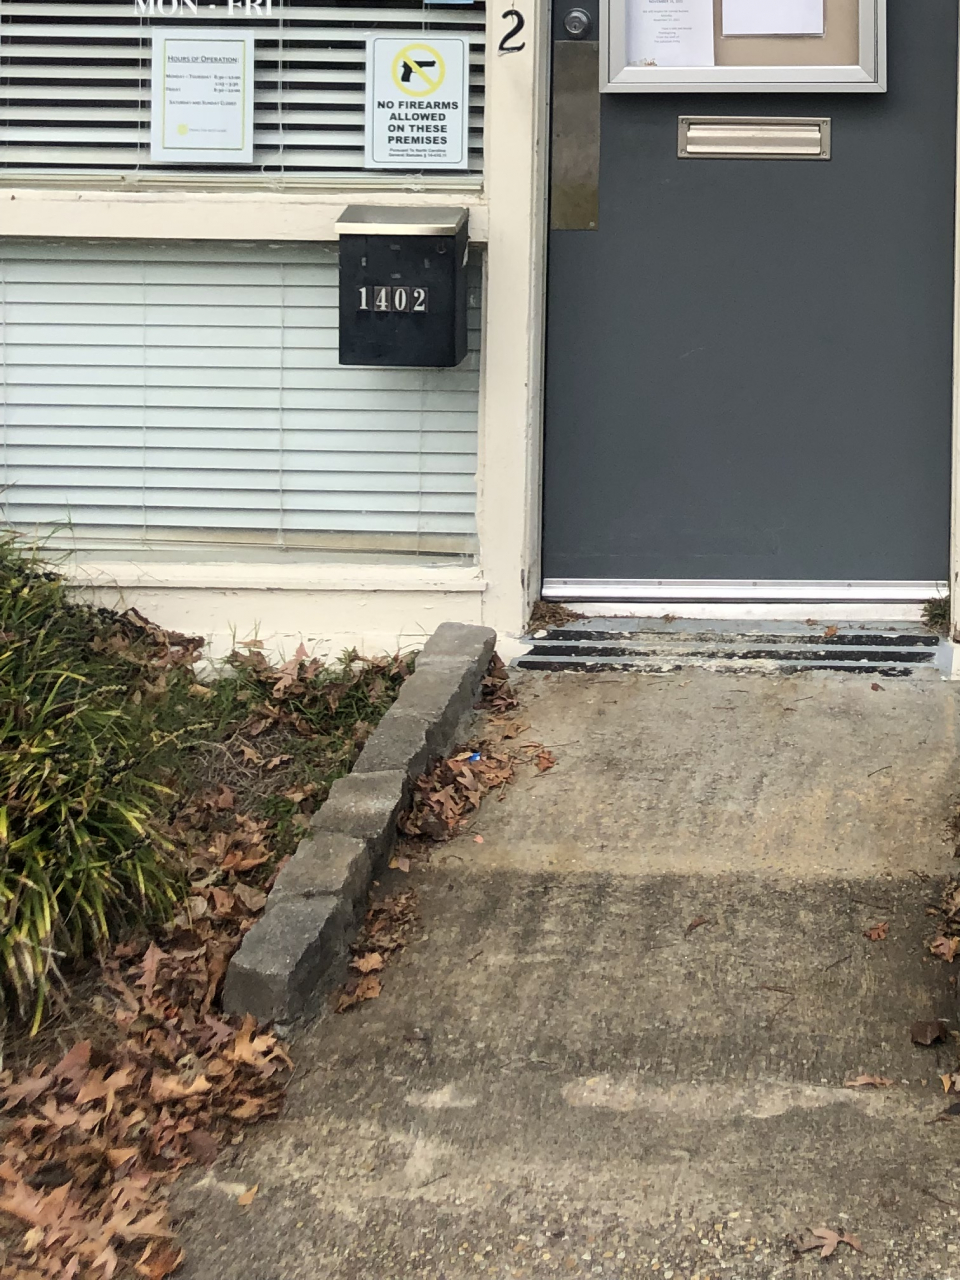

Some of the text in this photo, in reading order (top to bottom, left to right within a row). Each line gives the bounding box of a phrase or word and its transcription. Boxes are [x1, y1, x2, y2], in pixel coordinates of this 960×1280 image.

[377, 100, 459, 110] NO FIREARMS
[389, 112, 446, 121] ALLOWED
[387, 124, 447, 133] ON THESE
[387, 136, 448, 145] PREMISES
[358, 287, 426, 311] 1402
